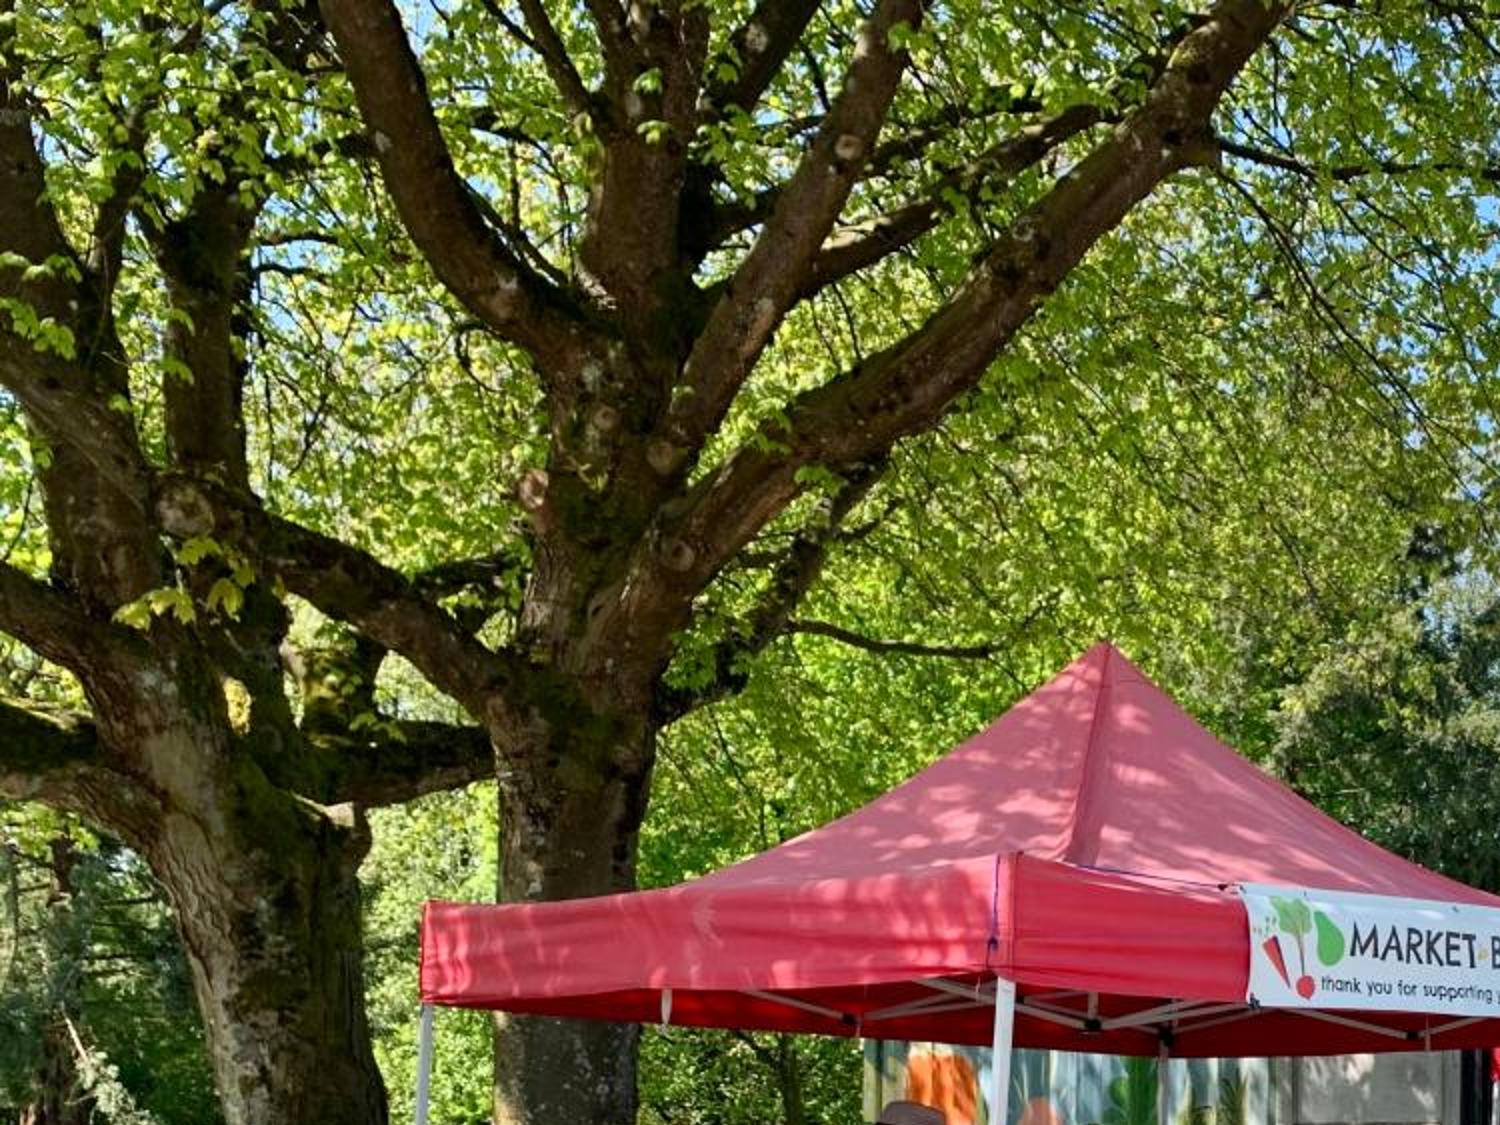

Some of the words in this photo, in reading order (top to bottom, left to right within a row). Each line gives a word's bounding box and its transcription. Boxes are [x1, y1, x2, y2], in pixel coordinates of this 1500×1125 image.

[1350, 920, 1477, 968] MARKET
[1321, 976, 1361, 993] thank
[1367, 980, 1393, 996] you
[1397, 980, 1417, 996] for
[1423, 984, 1493, 1005] supporting
